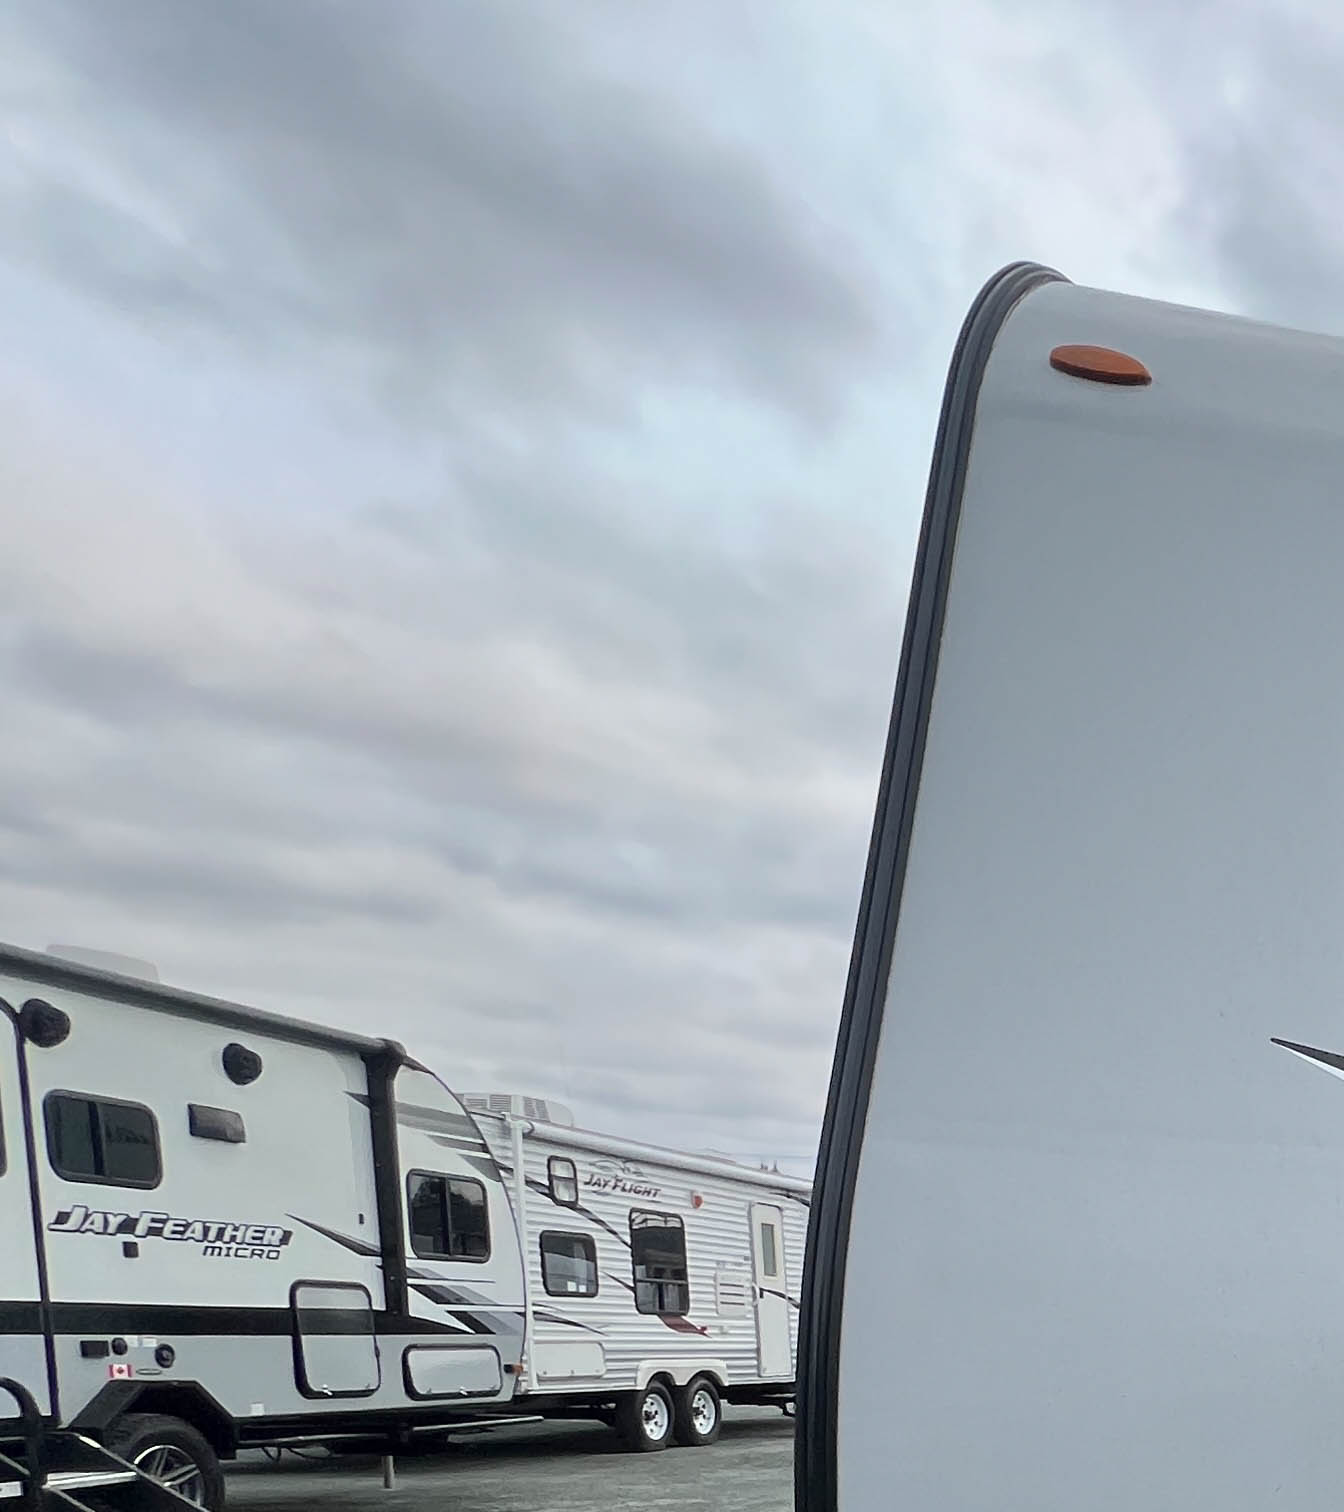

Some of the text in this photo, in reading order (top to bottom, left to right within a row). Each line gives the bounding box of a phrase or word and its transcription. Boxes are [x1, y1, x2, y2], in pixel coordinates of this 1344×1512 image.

[584, 1173, 661, 1198] JAY FLIGHT
[48, 1205, 285, 1247] JAY FEATHER
